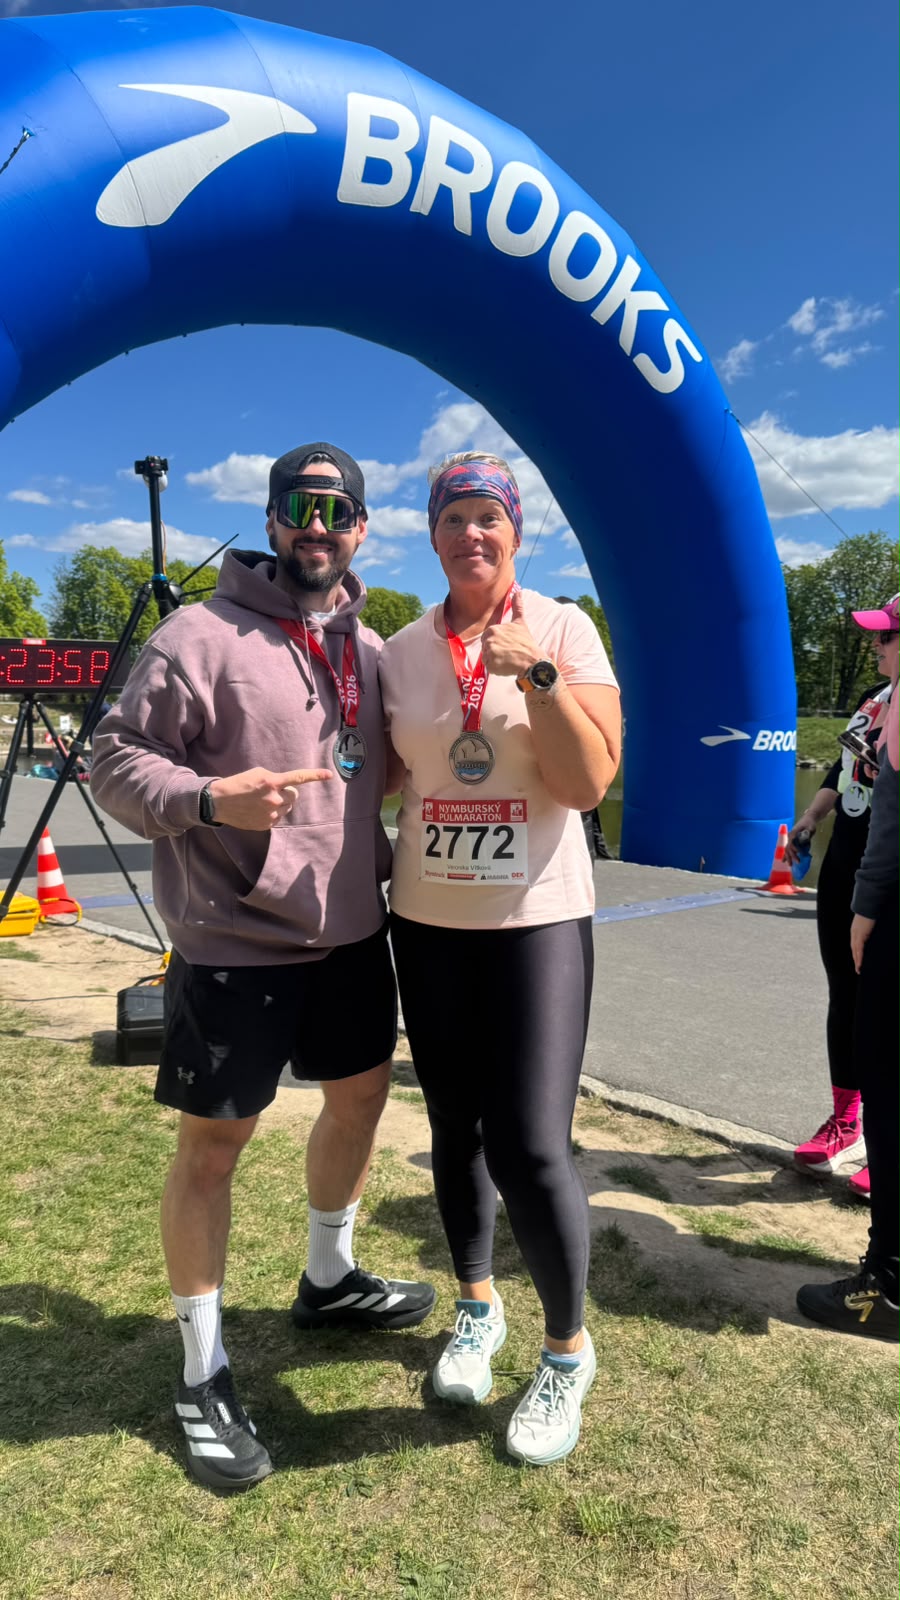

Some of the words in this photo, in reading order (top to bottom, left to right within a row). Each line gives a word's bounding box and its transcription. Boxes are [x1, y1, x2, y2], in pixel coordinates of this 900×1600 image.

[337, 92, 703, 394] BROOKS
[346, 675, 357, 705] 2026
[467, 677, 485, 709] 2026
[439, 802, 501, 813] NYMBURSKÝ
[425, 824, 515, 860] 2772
